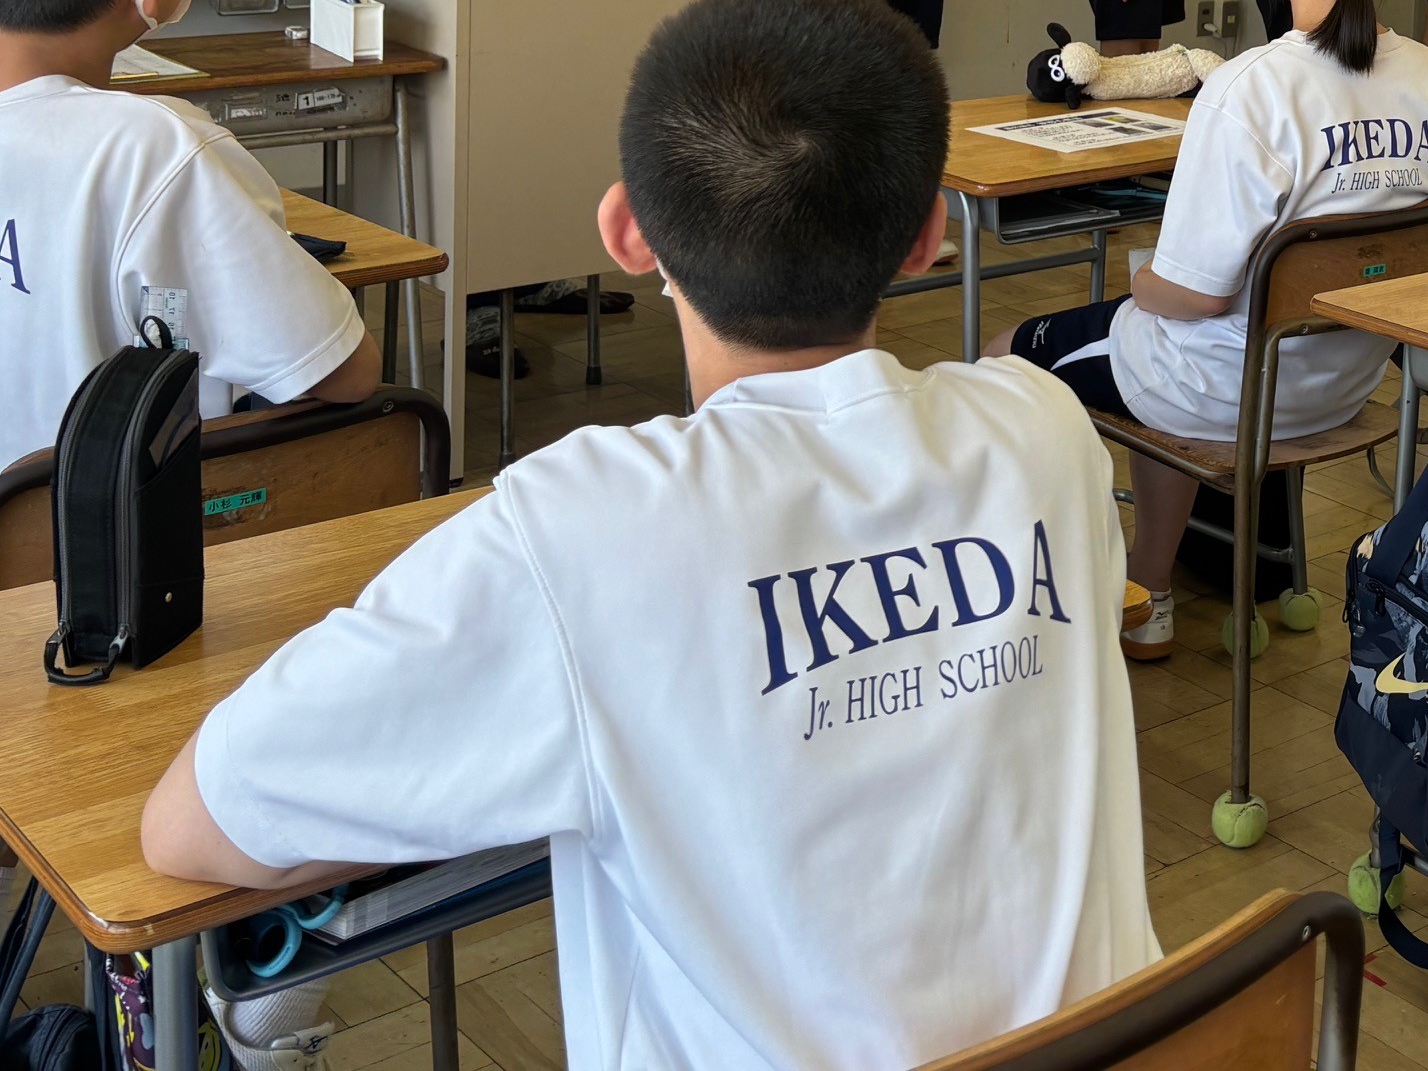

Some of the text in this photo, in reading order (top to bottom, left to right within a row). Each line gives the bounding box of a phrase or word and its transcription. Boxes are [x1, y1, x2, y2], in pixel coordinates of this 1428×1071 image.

[1331, 168, 1423, 194] Jr. HIGH SCHOOL
[747, 518, 1072, 696] IKEDA
[804, 634, 1043, 740] Jr. HIGH SCHOOL
